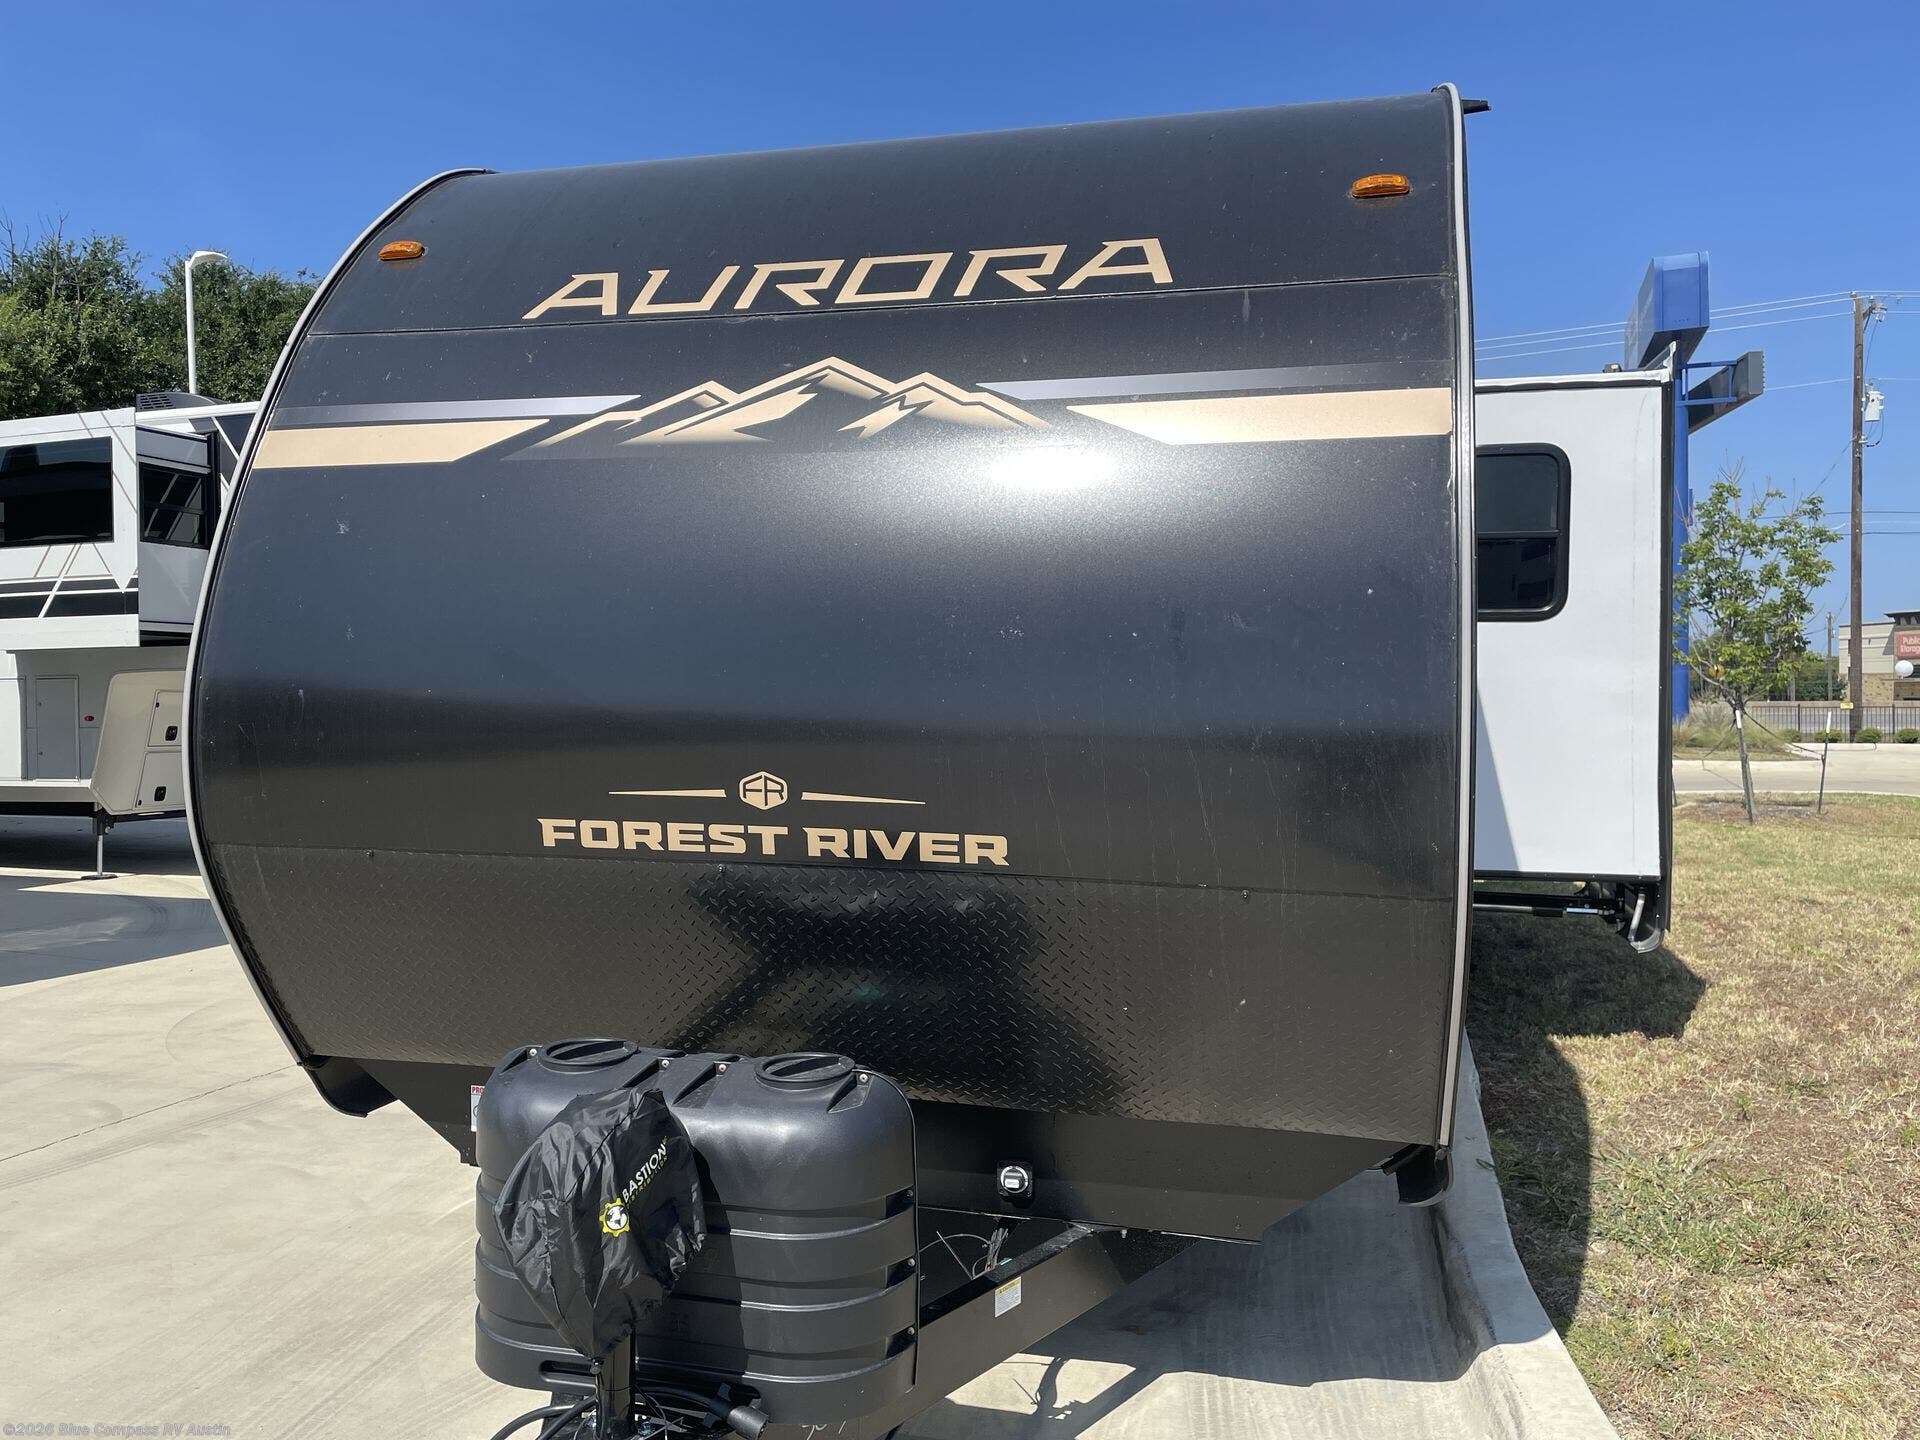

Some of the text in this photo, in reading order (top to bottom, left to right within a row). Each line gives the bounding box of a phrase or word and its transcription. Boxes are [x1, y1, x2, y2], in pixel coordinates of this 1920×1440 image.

[522, 237, 1173, 319] AURORA
[1900, 644, 1920, 655] Storag
[742, 774, 785, 807] FR
[537, 817, 1010, 867] FOREST RIVER
[622, 1143, 667, 1203] BASTION
